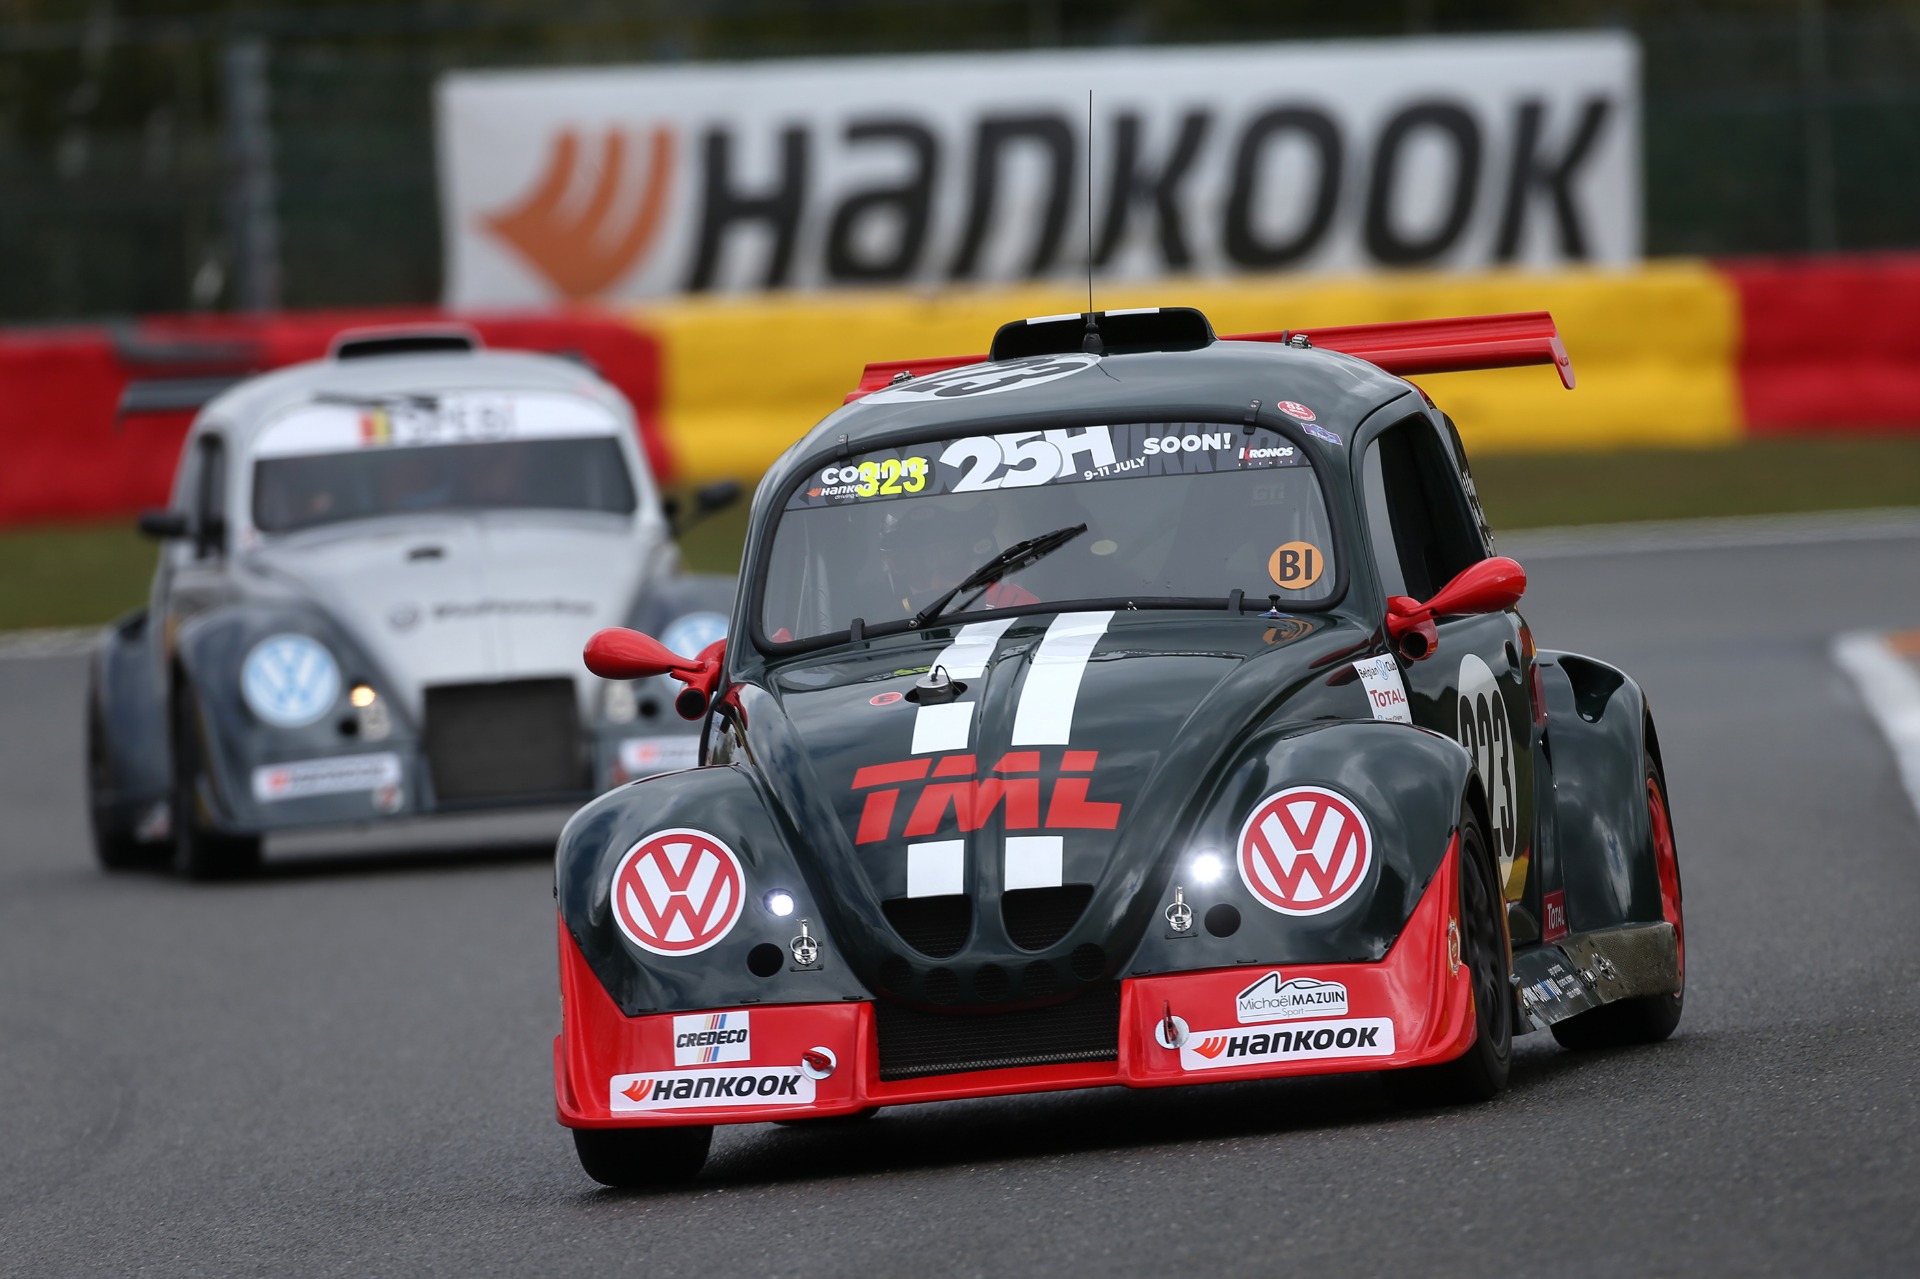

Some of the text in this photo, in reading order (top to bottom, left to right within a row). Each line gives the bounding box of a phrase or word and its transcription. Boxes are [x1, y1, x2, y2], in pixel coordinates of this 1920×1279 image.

[1143, 432, 1232, 455] SOON!
[1239, 445, 1294, 460] KRONOS
[939, 425, 1117, 493] 25H
[1084, 456, 1147, 481] 9-11 JULY
[857, 456, 926, 497] 323
[1279, 549, 1313, 581] BI
[1358, 665, 1379, 680] Belgian
[1369, 688, 1406, 708] TOTAL
[851, 750, 1122, 845] TML
[1243, 792, 1366, 910] VW
[617, 833, 740, 950] VW
[1547, 903, 1565, 930] TOTAL
[1281, 1007, 1304, 1018] Sport
[676, 1029, 748, 1048] CREDECO
